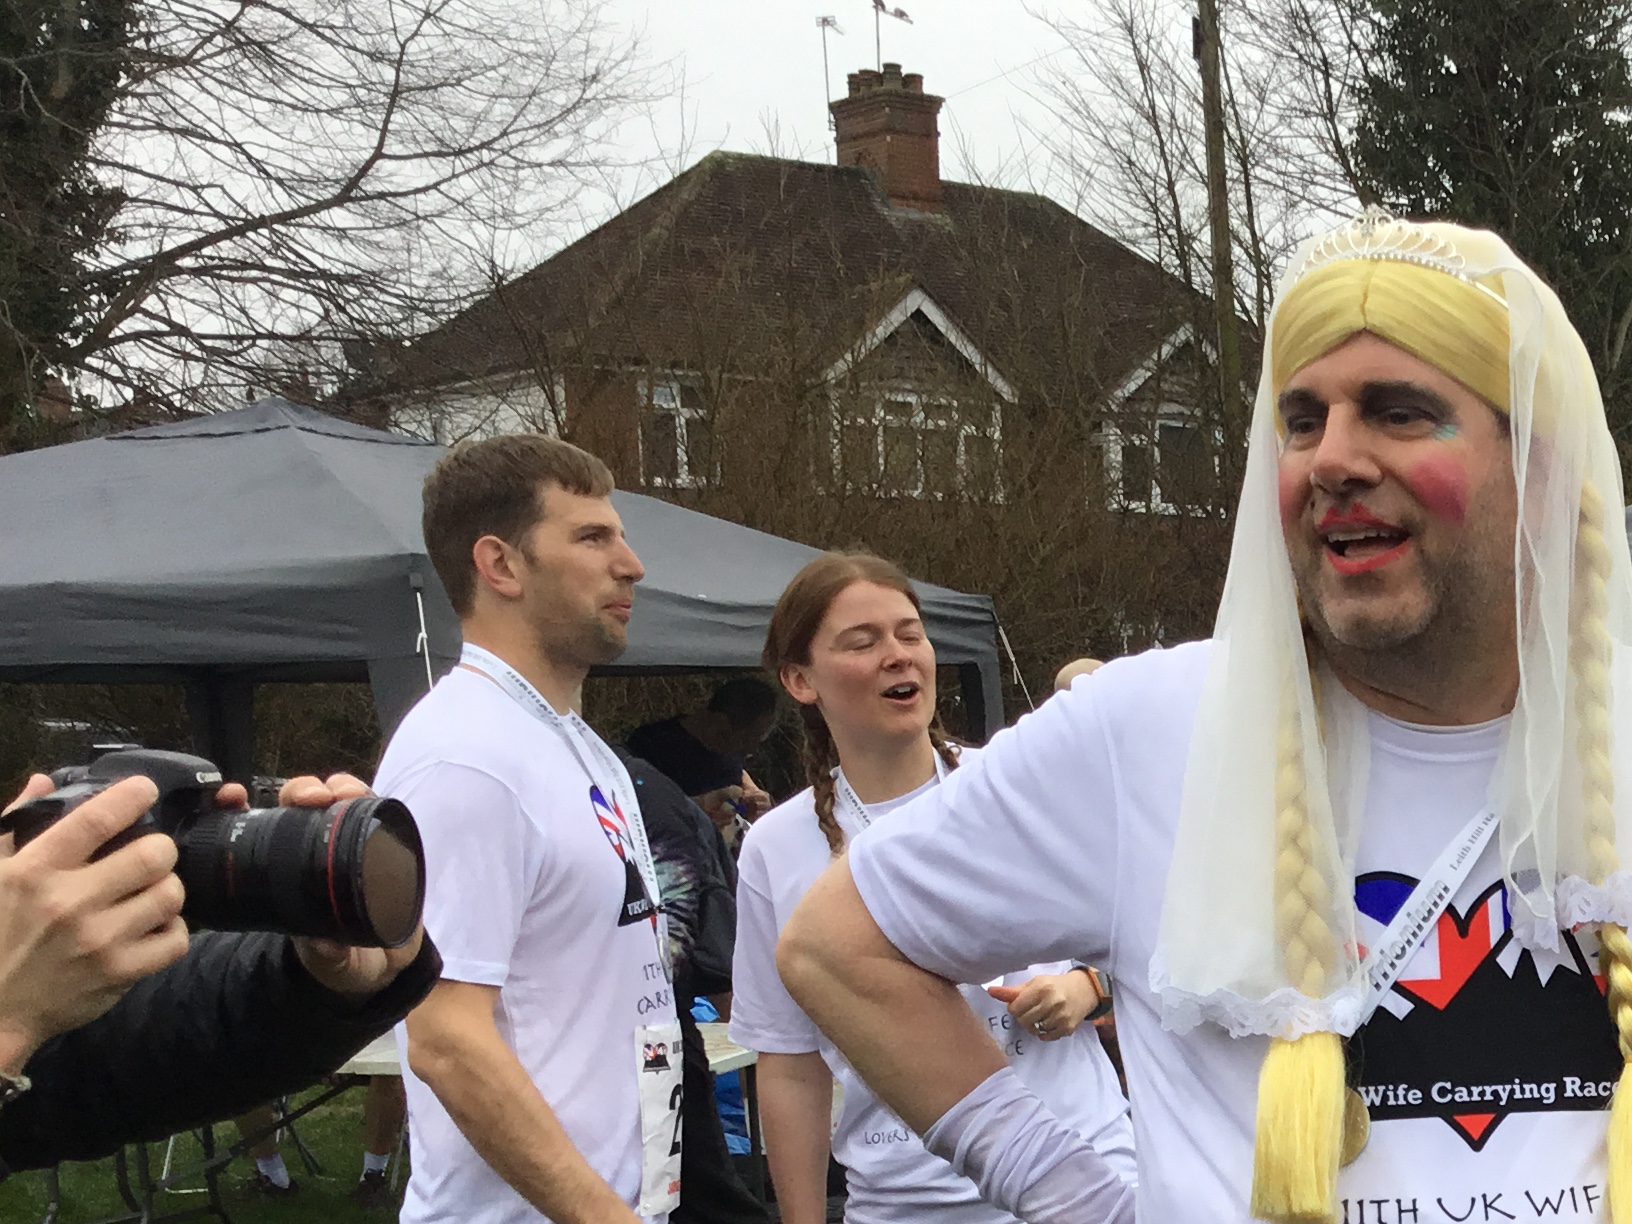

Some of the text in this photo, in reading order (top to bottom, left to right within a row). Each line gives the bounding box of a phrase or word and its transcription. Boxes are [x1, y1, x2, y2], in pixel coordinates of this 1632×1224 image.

[1449, 847, 1471, 871] Leith
[1468, 826, 1485, 844] Hill
[1358, 1084, 1423, 1107] Wife
[1431, 1078, 1557, 1106] Carrying
[1436, 1193, 1516, 1222] UK
[1524, 1184, 1601, 1217] WIF
